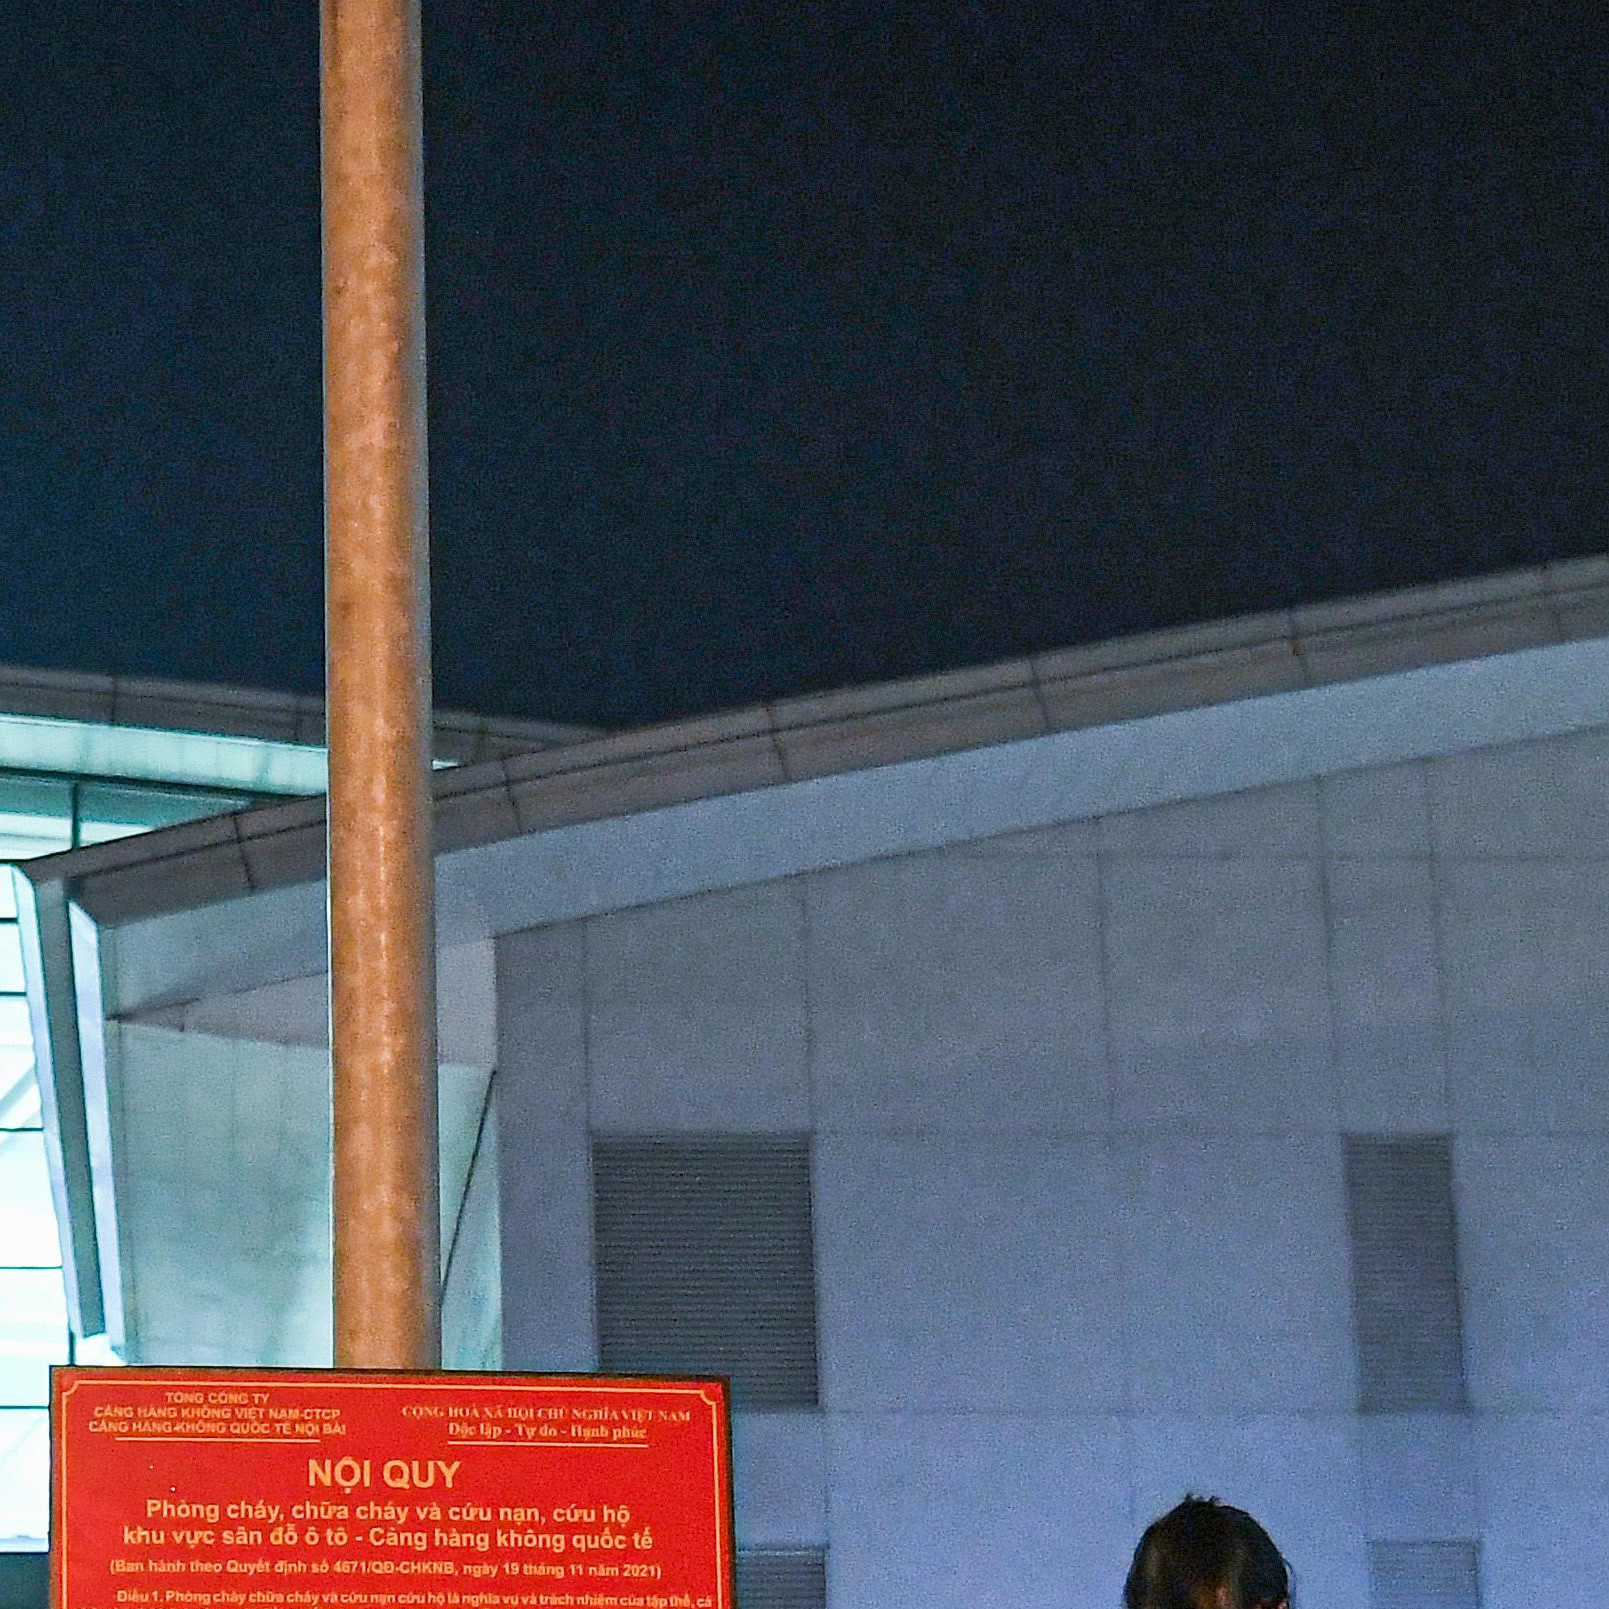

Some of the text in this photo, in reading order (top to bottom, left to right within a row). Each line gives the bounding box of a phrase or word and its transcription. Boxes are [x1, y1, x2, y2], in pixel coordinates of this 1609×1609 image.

[308, 1455, 460, 1493] NỘI QUY
[146, 1498, 630, 1525] Phòng cháy, chữa cháy và cứu nạn, cứu hộ
[123, 1525, 165, 1544] khu
[172, 1530, 215, 1549] vực
[221, 1526, 262, 1545] sân
[269, 1523, 298, 1545] đỗ
[304, 1526, 319, 1545] ô
[325, 1526, 348, 1546] tô
[368, 1526, 427, 1551] Cảng
[433, 1527, 490, 1551] hàng
[496, 1524, 566, 1553] không
[571, 1524, 627, 1552] quốc
[632, 1525, 653, 1549] tế
[109, 1558, 144, 1575] (Ban
[147, 1559, 186, 1572] hành
[189, 1559, 222, 1573] theo
[225, 1559, 271, 1576] Quyết
[273, 1560, 307, 1576] định
[310, 1559, 329, 1573] số
[462, 1562, 498, 1578] ngày
[503, 1561, 520, 1575] 19
[522, 1562, 565, 1578] tháng
[569, 1563, 583, 1576] 11
[587, 1563, 619, 1576] năm
[622, 1564, 662, 1579] 2021)
